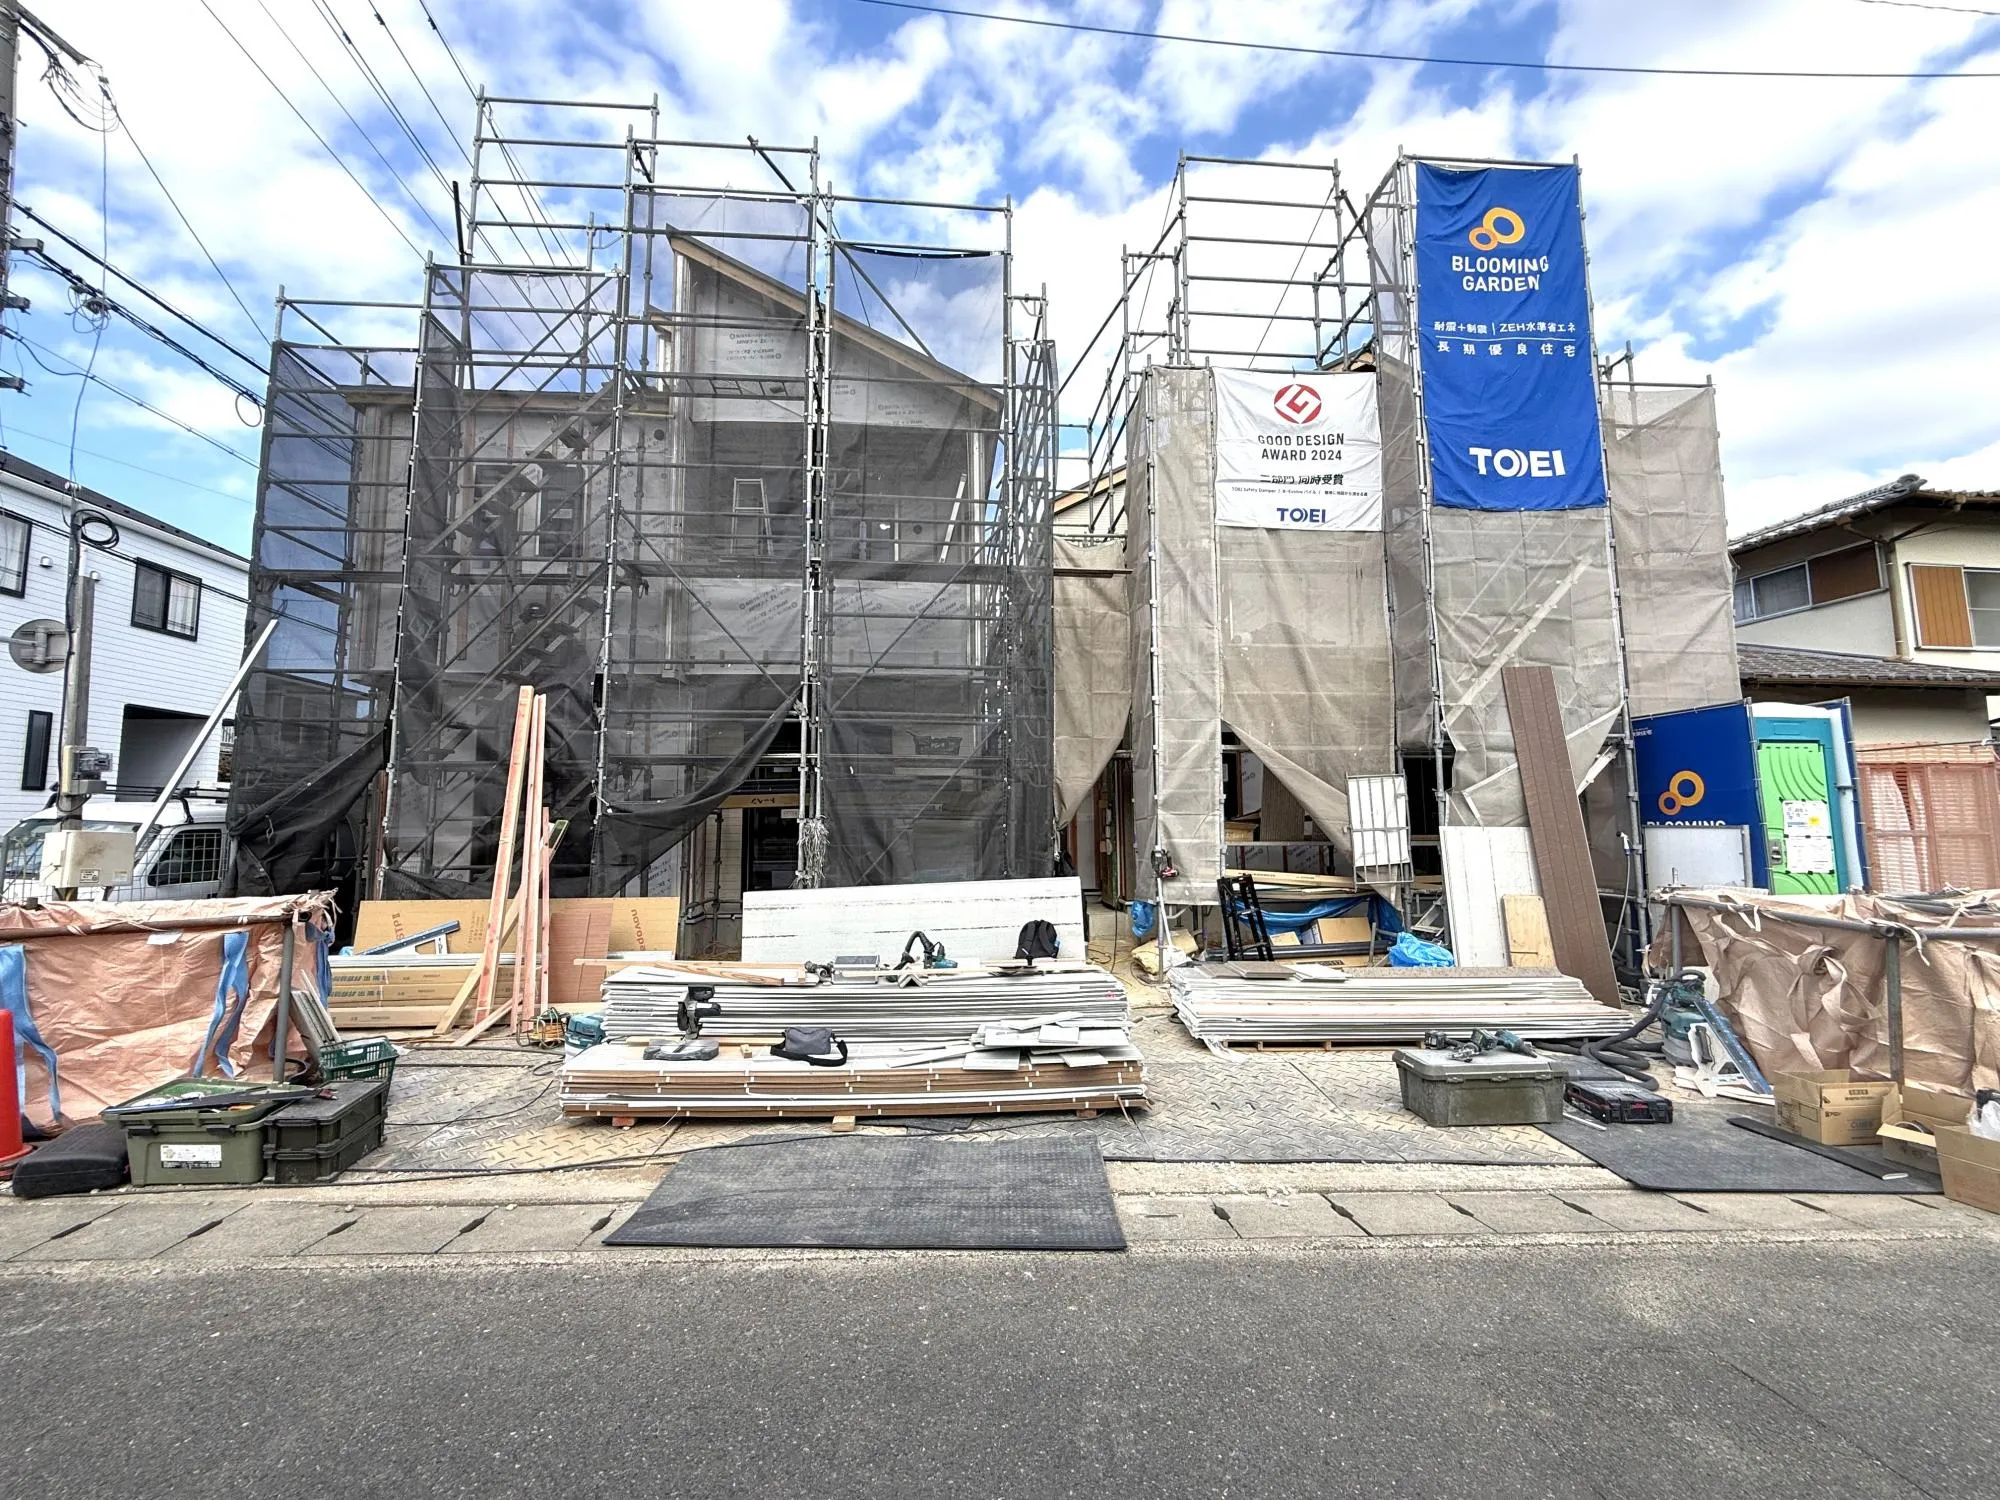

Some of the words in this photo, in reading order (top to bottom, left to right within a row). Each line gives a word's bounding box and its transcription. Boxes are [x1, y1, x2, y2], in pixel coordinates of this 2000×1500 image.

[1451, 255, 1549, 274] BLOOMING
[1462, 274, 1540, 292] GARDEN
[1437, 341, 1576, 357] 長期優良住宅
[1257, 435, 1292, 446] GOOD
[1296, 433, 1345, 446] DESIGN
[1261, 448, 1307, 461] AWARD
[1311, 449, 1342, 461] 2024
[1468, 447, 1566, 478] TOEI
[1276, 507, 1326, 523] TOEI
